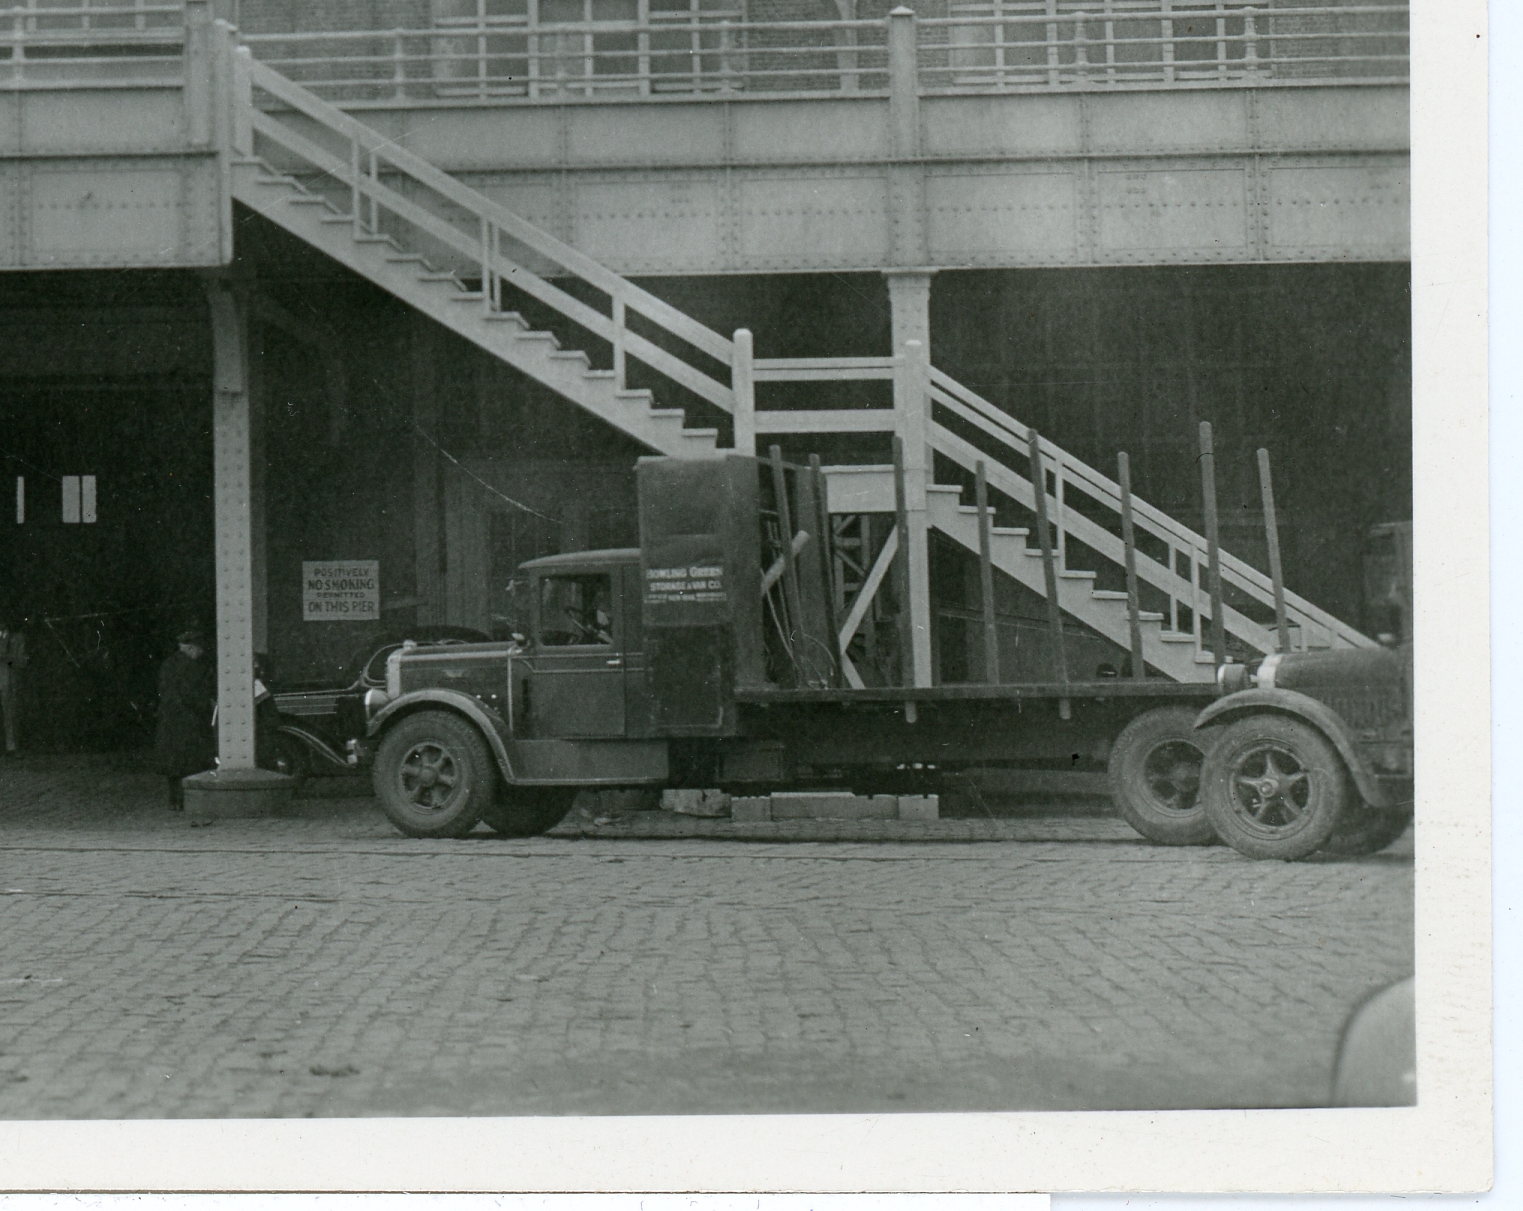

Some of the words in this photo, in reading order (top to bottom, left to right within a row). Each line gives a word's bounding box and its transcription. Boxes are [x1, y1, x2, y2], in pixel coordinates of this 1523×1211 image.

[314, 568, 370, 577] POSITIVELY
[308, 579, 323, 590] NO
[325, 578, 375, 590] SMOKING
[308, 601, 322, 613] ON
[324, 600, 349, 613] THIS
[351, 600, 375, 613] PIER
